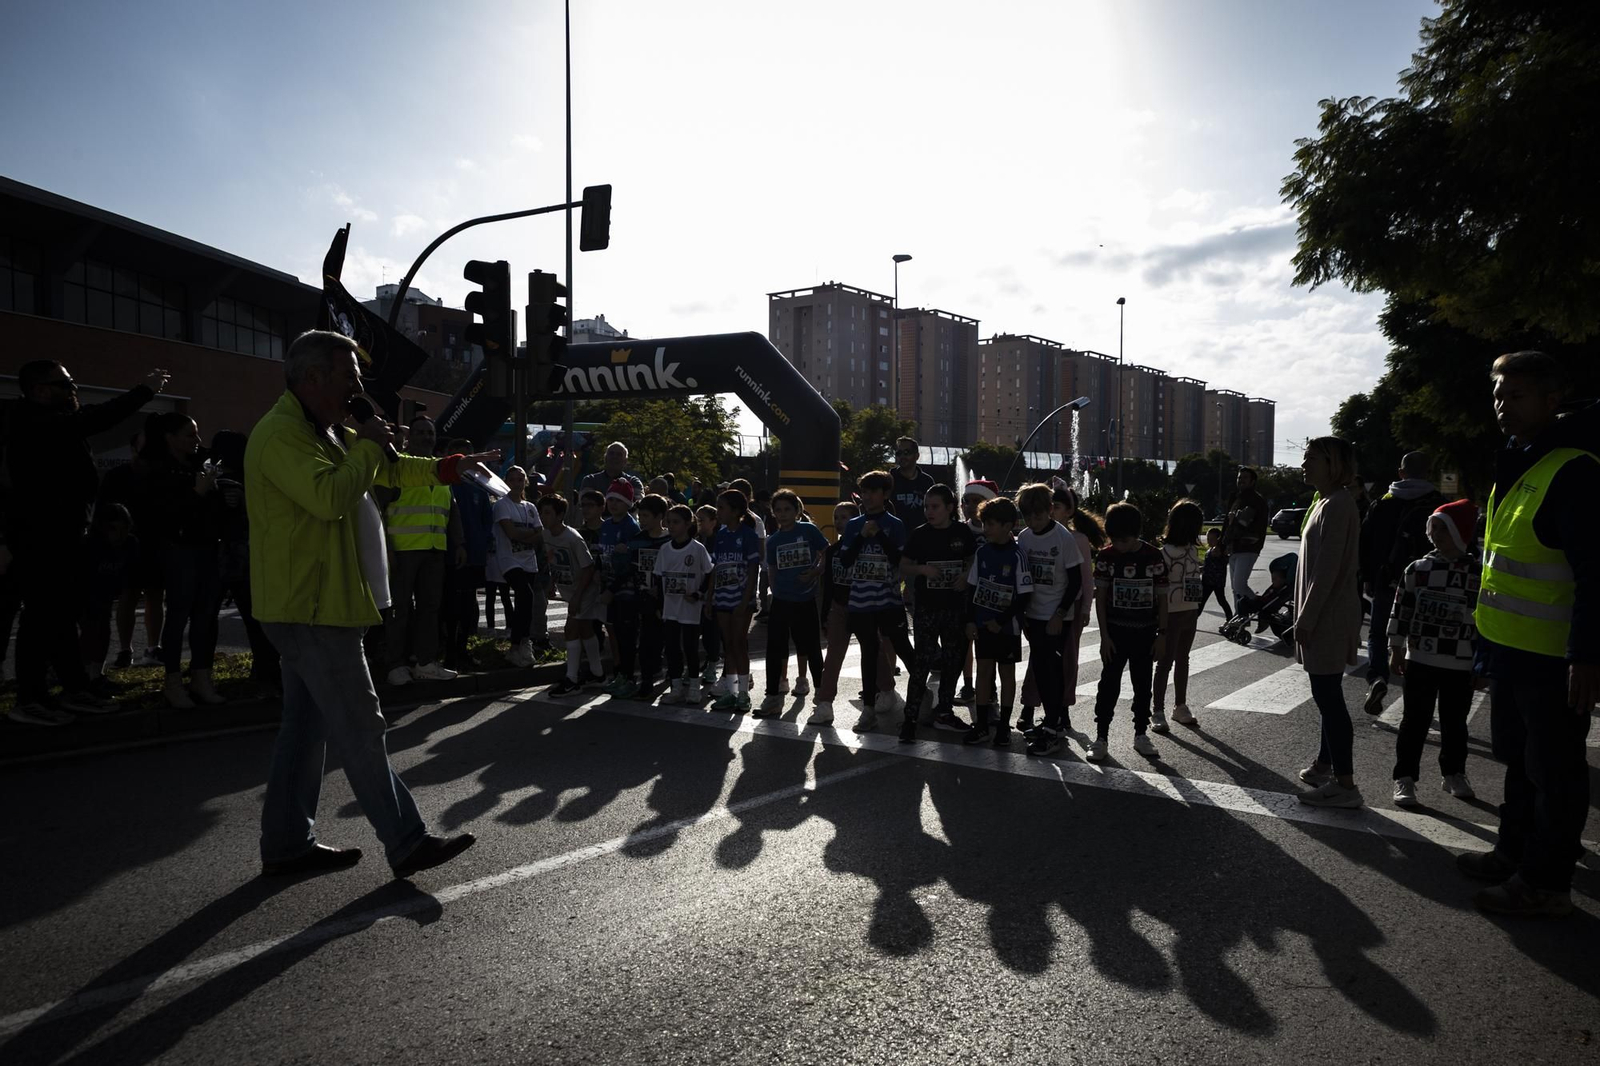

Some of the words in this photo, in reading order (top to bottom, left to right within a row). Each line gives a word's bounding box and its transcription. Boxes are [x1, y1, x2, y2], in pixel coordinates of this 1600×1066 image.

[553, 347, 698, 394] nnink.
[735, 365, 791, 425] runnink.com
[780, 549, 800, 563] 564
[855, 562, 875, 576] 562
[977, 588, 999, 604] 536
[1116, 587, 1140, 601] 542
[1419, 598, 1443, 617] 546
